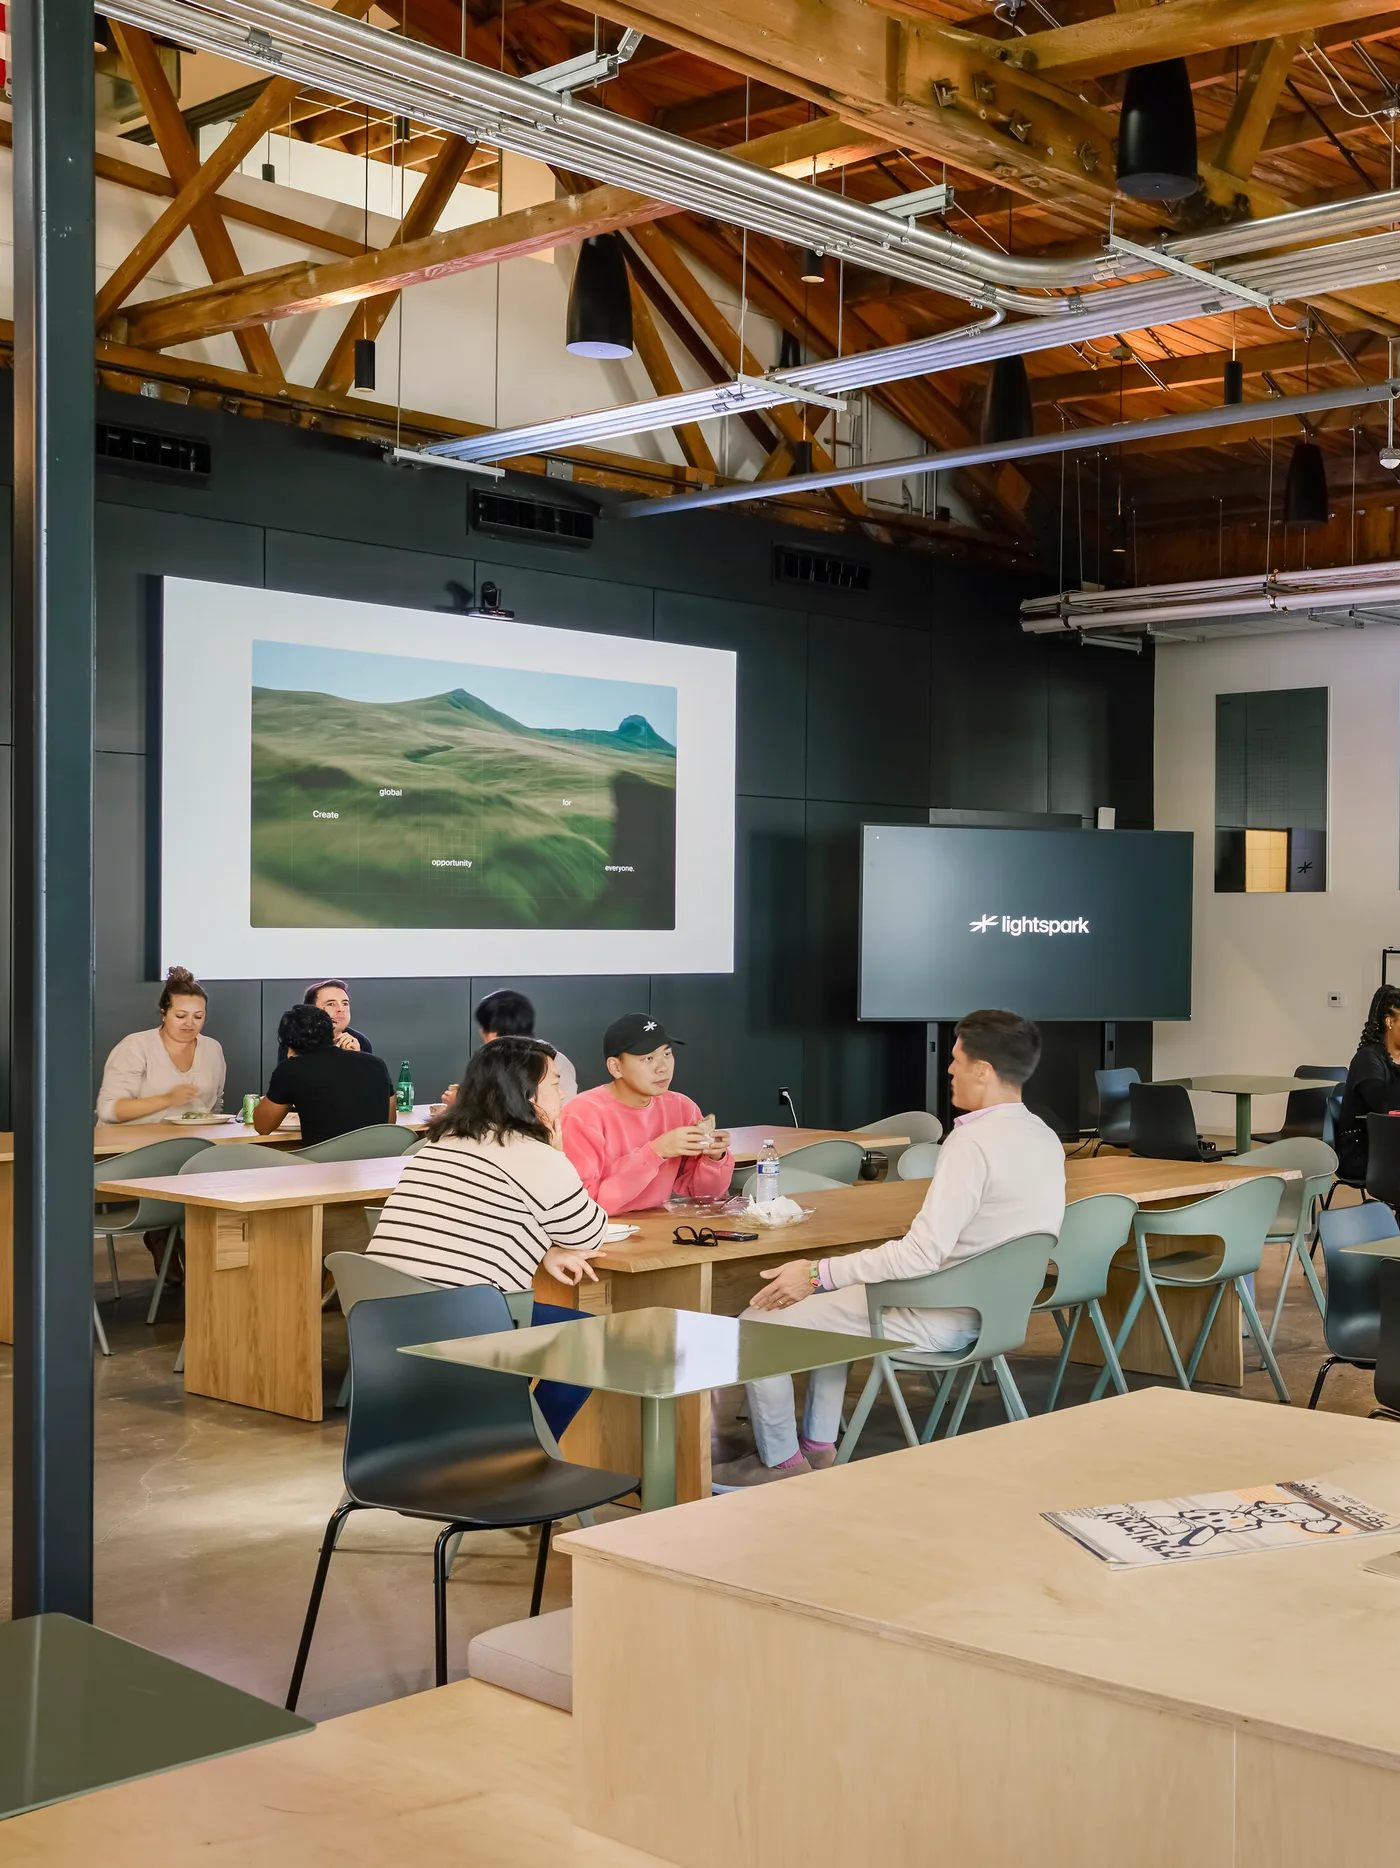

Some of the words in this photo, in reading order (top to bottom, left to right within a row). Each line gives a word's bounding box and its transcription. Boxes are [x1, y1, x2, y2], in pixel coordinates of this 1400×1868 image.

[379, 788, 403, 797] global
[312, 810, 339, 819] Create
[431, 859, 472, 868] opportunity
[604, 865, 635, 873] everyone.
[1001, 915, 1090, 936] lightspark
